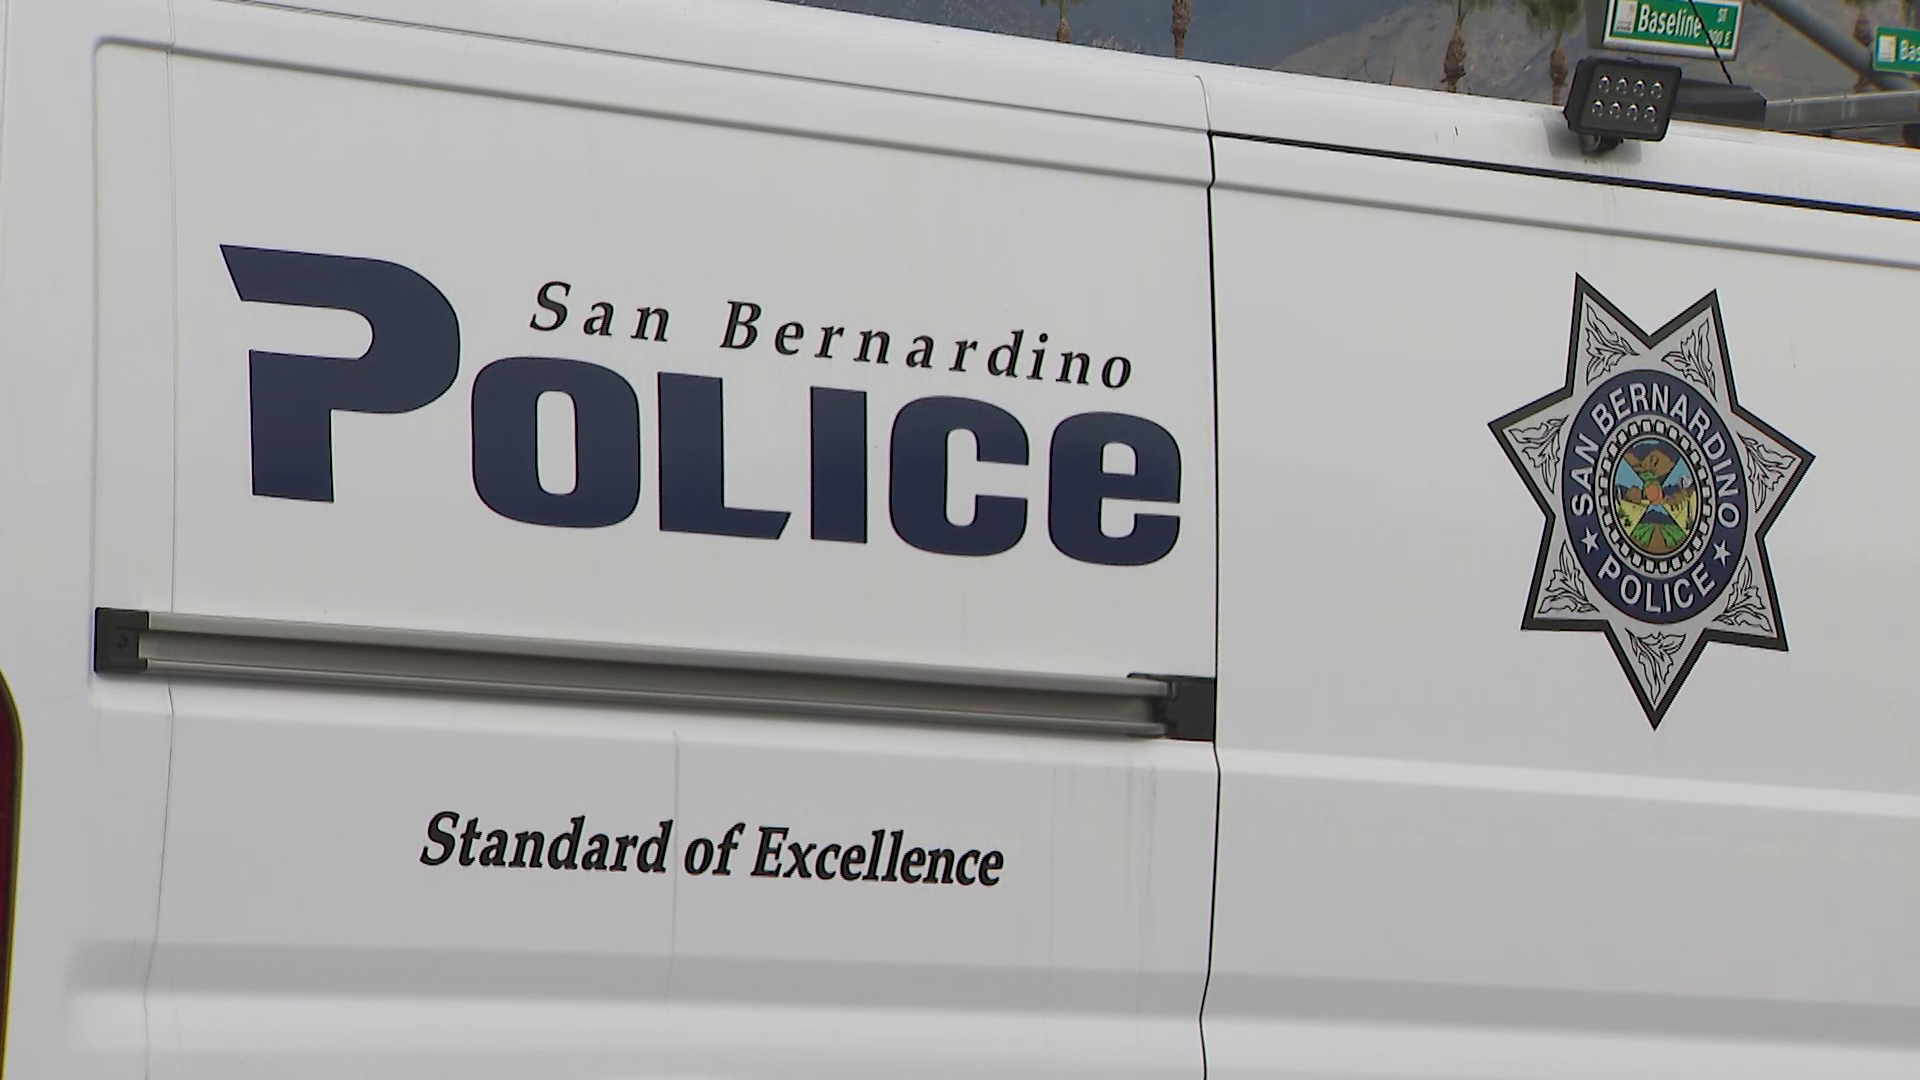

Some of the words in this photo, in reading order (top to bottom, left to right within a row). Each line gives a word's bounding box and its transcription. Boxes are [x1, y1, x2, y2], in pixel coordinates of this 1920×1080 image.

[1638, 4, 1702, 39] Baseline
[1716, 7, 1729, 24] ST
[529, 281, 669, 342] San
[719, 301, 1131, 389] Bernardino
[1571, 433, 1600, 517] SAN
[1590, 382, 1740, 529] BERNARDINO
[1597, 554, 1716, 614] POLICE
[420, 811, 673, 873] Standard
[685, 822, 746, 877] of
[750, 826, 1004, 886] Excellence
